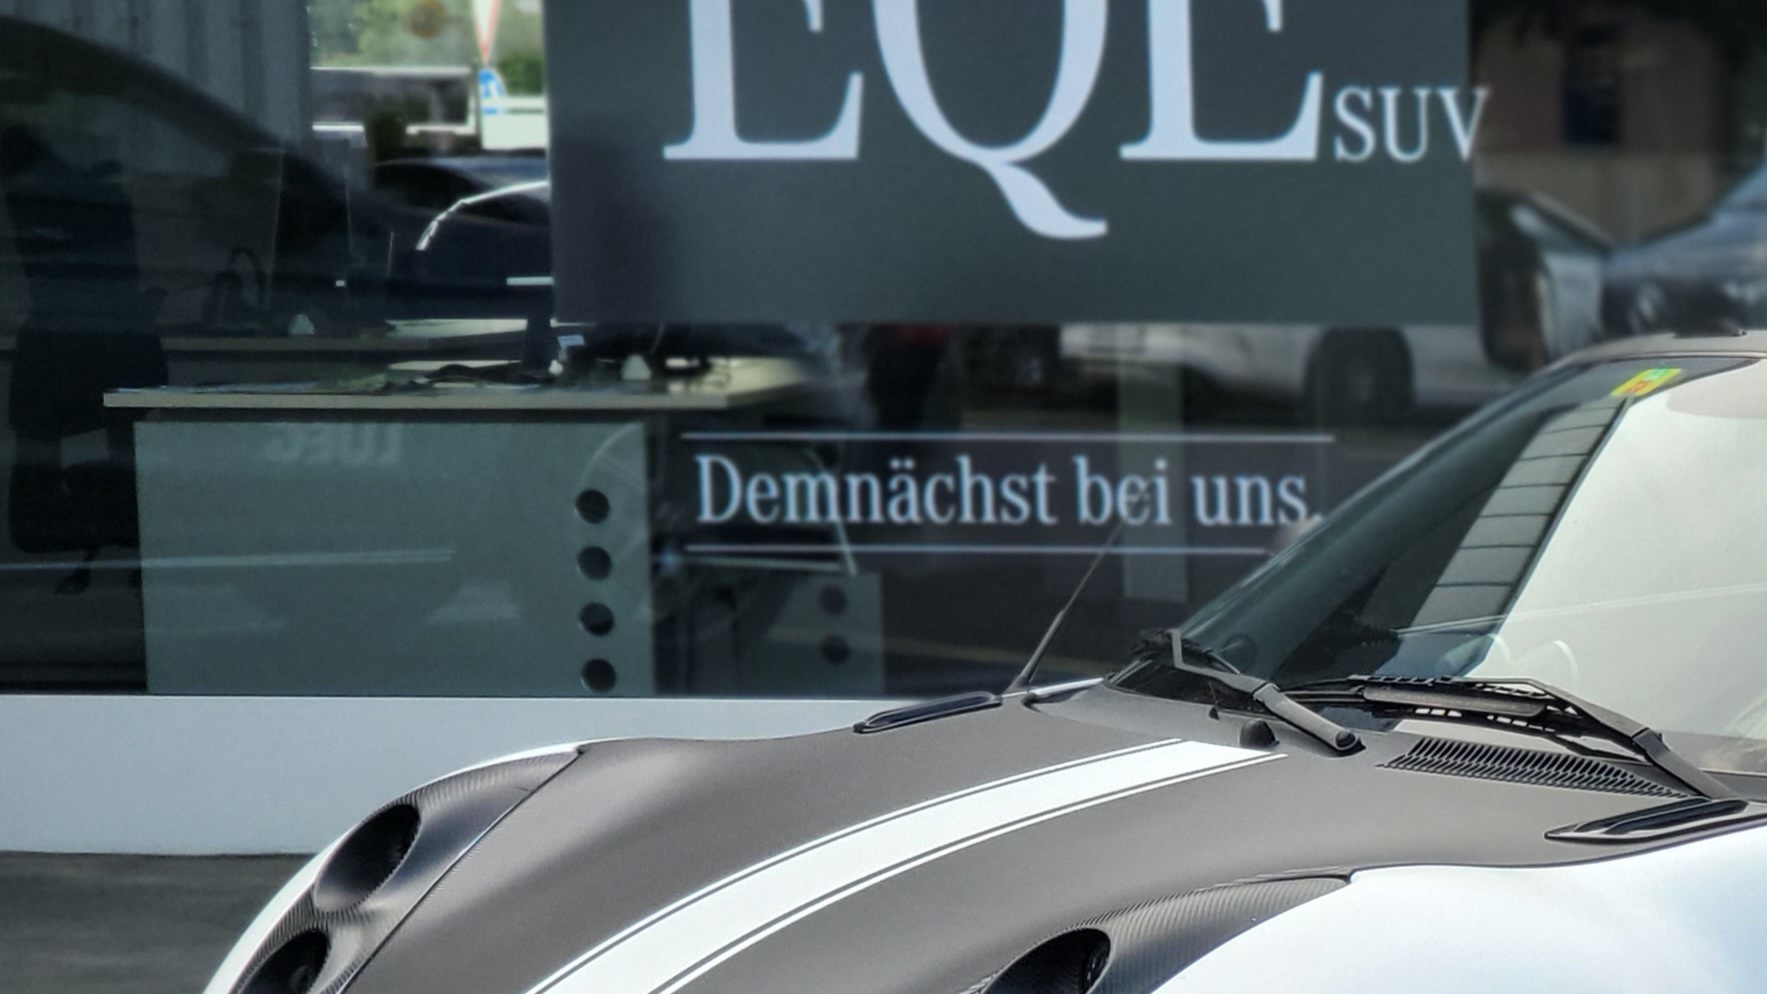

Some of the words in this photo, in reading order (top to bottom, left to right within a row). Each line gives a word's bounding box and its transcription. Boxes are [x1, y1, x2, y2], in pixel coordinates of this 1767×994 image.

[1333, 87, 1490, 163] SUV
[694, 454, 1057, 525] Demnächst
[1074, 455, 1172, 526] bei
